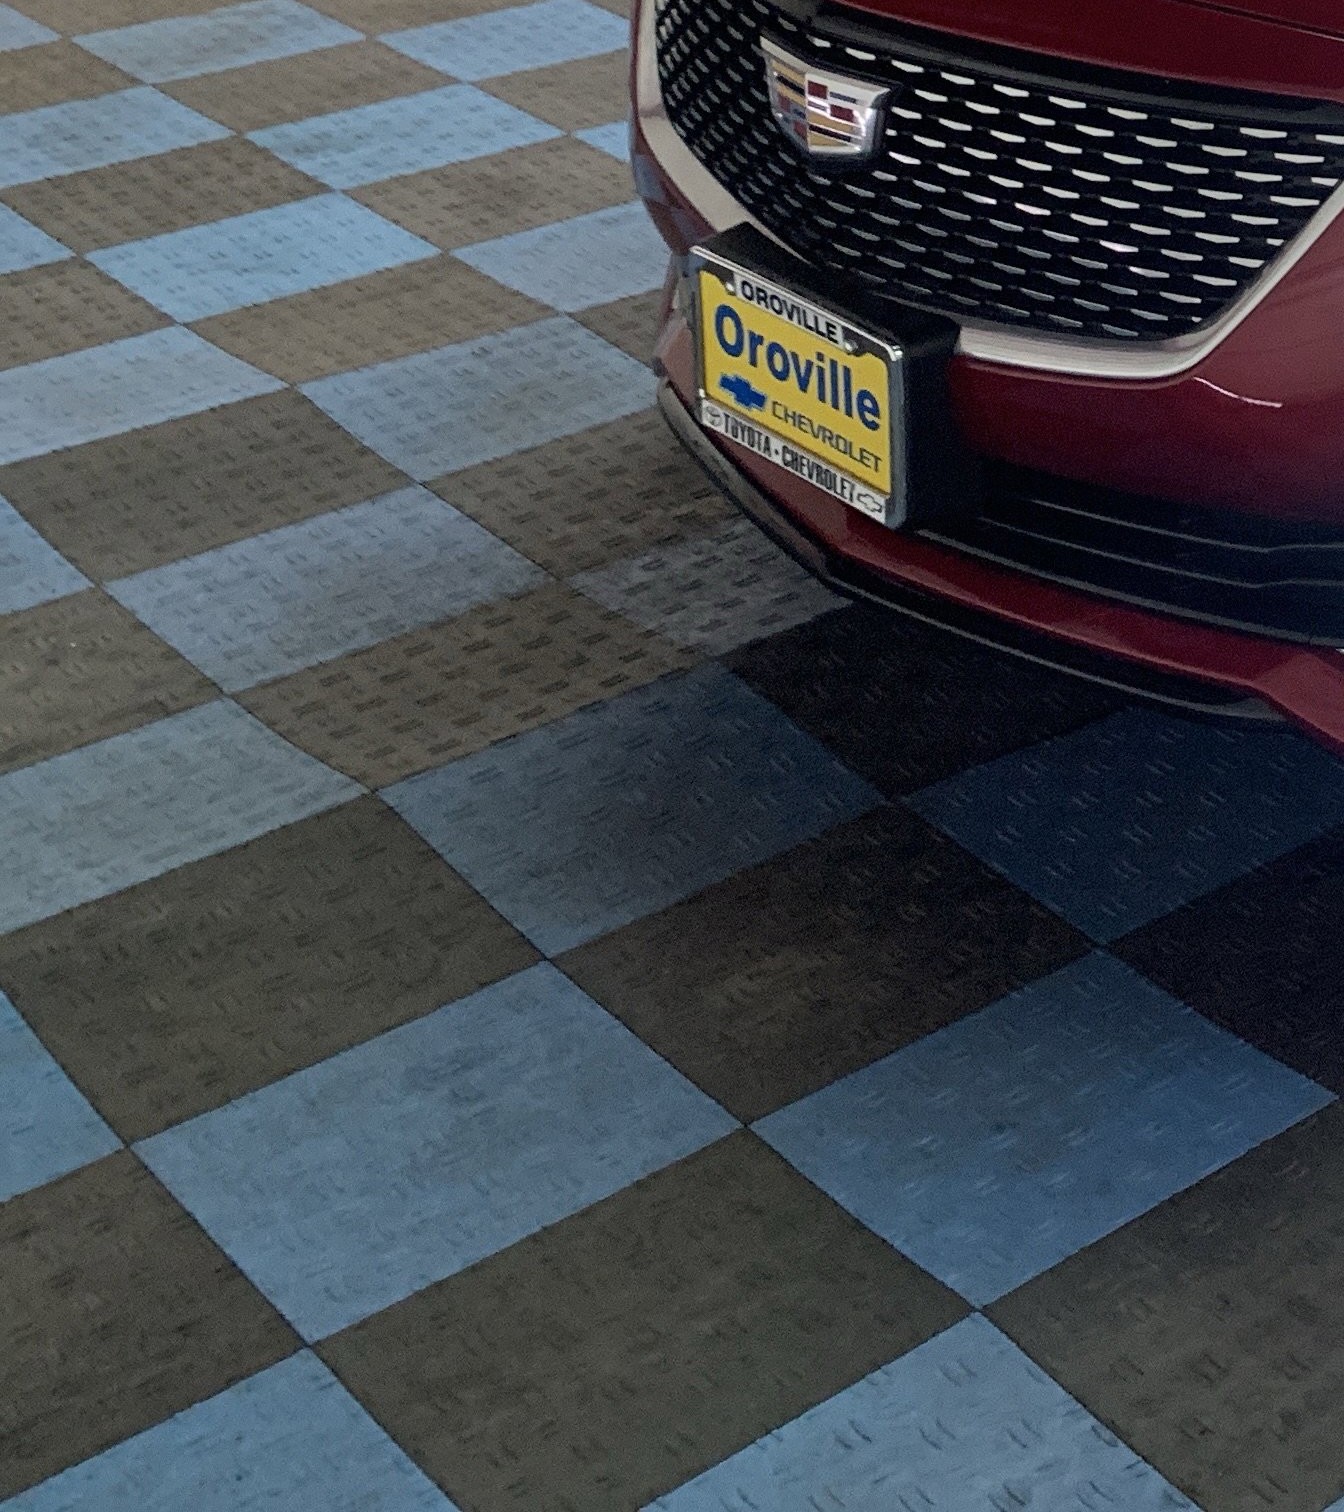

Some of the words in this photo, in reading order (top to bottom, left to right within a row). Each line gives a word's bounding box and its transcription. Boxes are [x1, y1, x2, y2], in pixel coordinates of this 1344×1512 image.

[741, 279, 839, 344] OROVILLE
[715, 304, 882, 431] Oroville
[722, 412, 772, 458] TOYOTA
[782, 445, 856, 503] CHEVROLET
[771, 400, 883, 473] CHEVROLET
